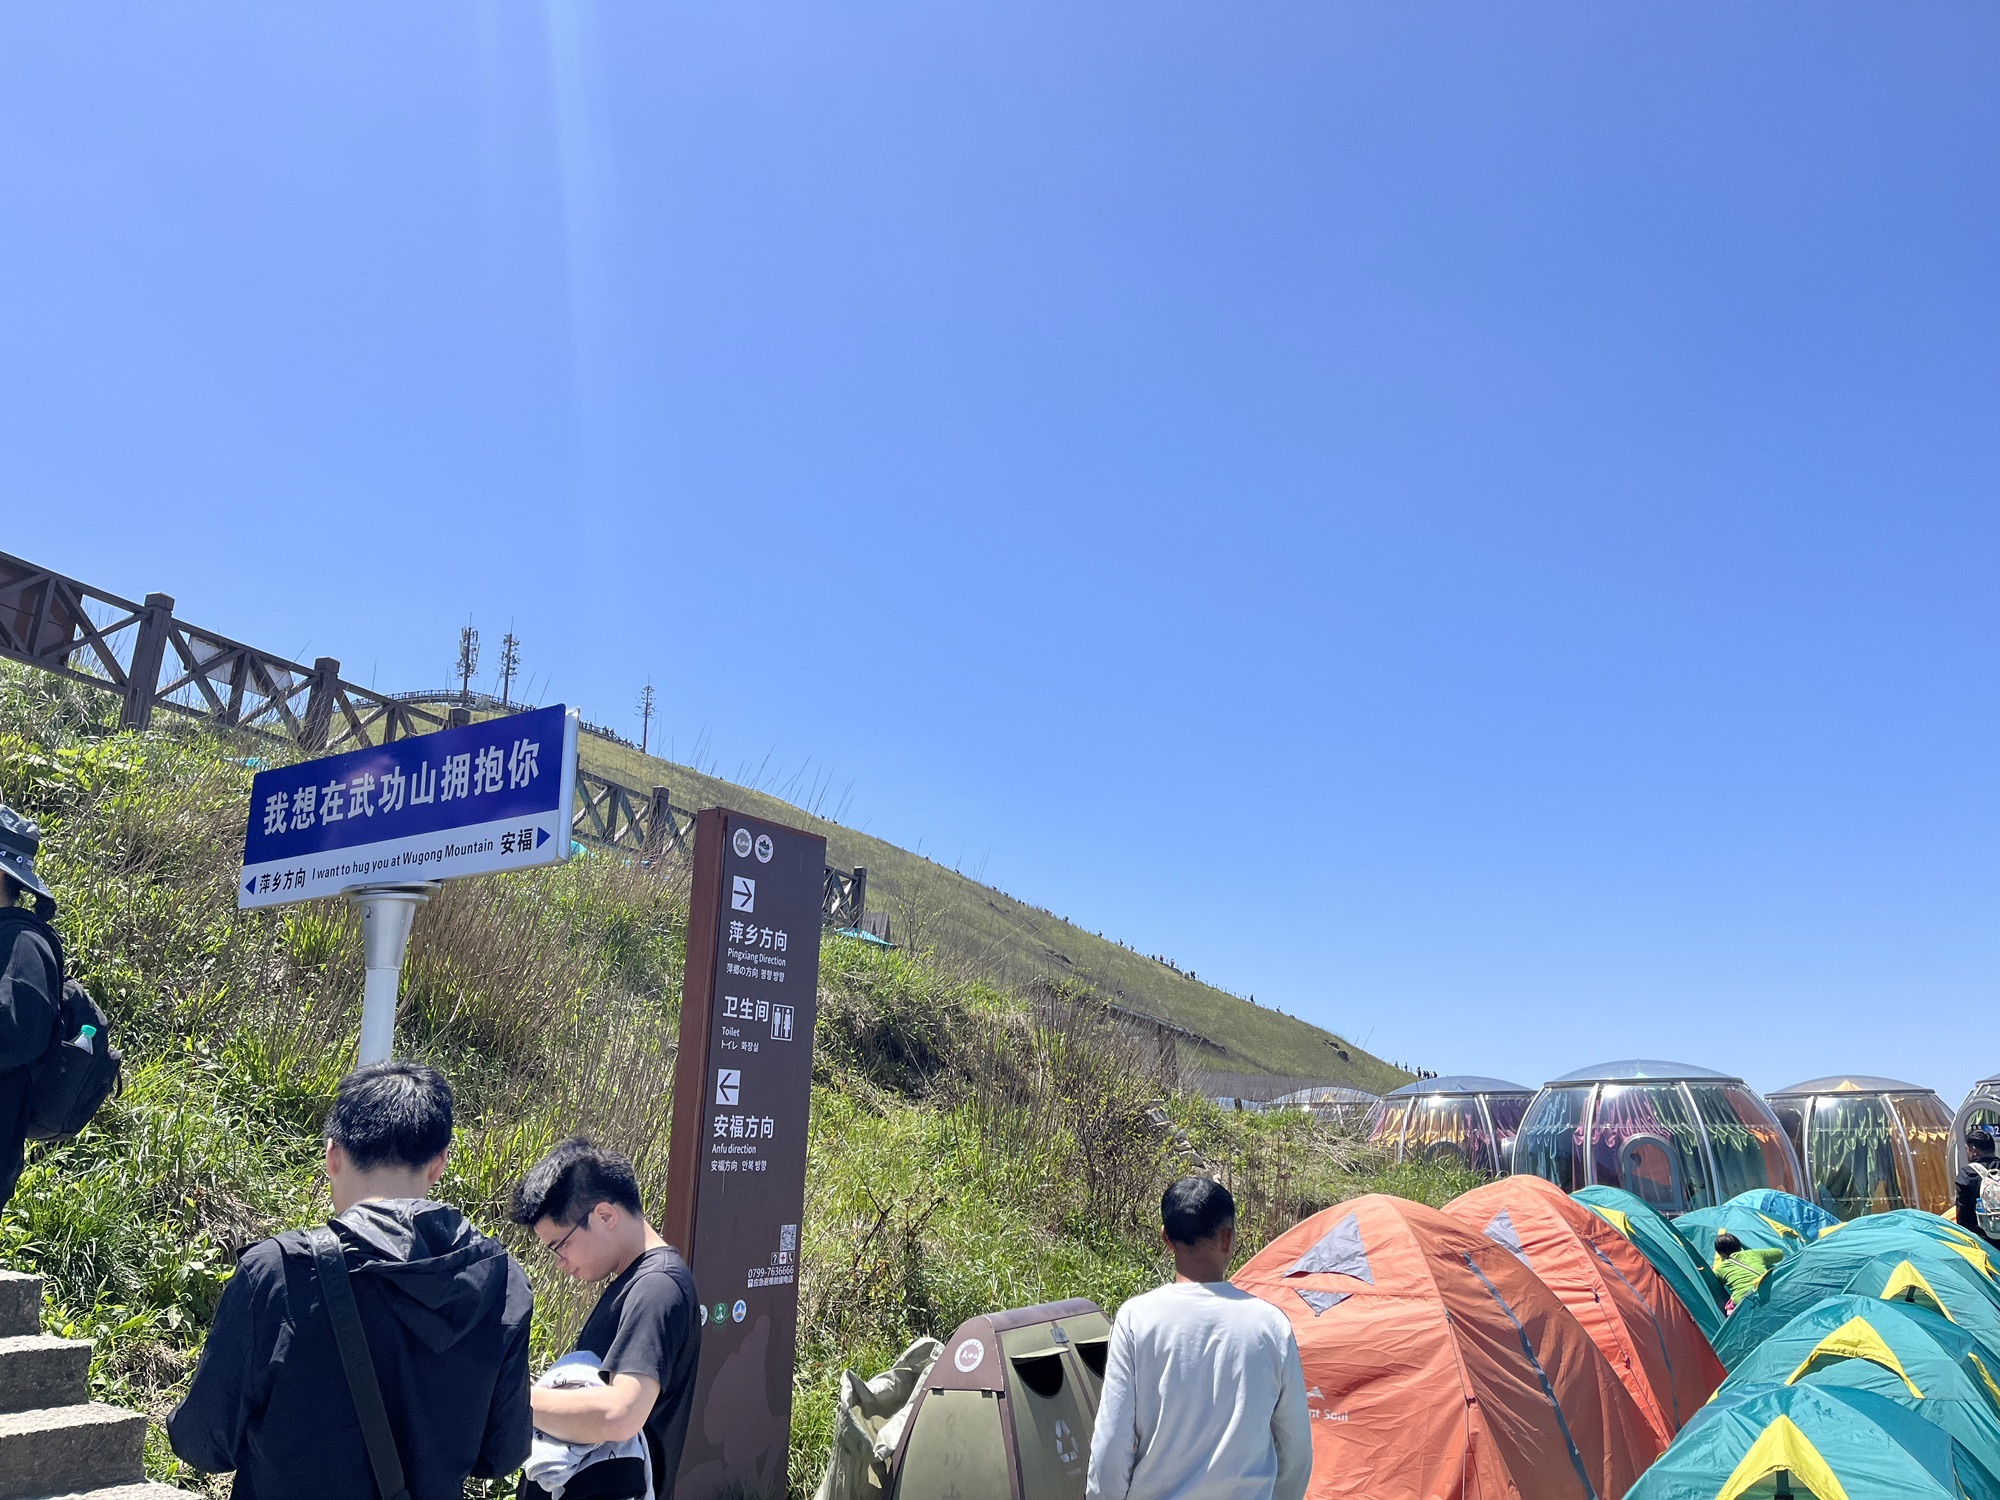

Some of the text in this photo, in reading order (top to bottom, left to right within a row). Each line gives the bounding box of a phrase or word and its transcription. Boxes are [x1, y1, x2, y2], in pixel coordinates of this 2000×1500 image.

[264, 738, 540, 835] 我想在武功山拥抱你
[501, 827, 533, 855] 安福
[312, 839, 494, 880] I want to hug you at Wugong Mountain
[259, 868, 306, 894] 萍乡方向
[728, 920, 788, 952] 萍乡方向
[727, 947, 786, 967] Pingxiang Direction
[722, 996, 769, 1022] 卫生间
[721, 1026, 740, 1037] Toilet
[721, 1039, 739, 1050] トイレ
[713, 1114, 774, 1139] 安福方向
[711, 1143, 757, 1154] Anfu direction
[747, 1265, 794, 1278] 0799-7636666
[1323, 1408, 1349, 1422] Soul
